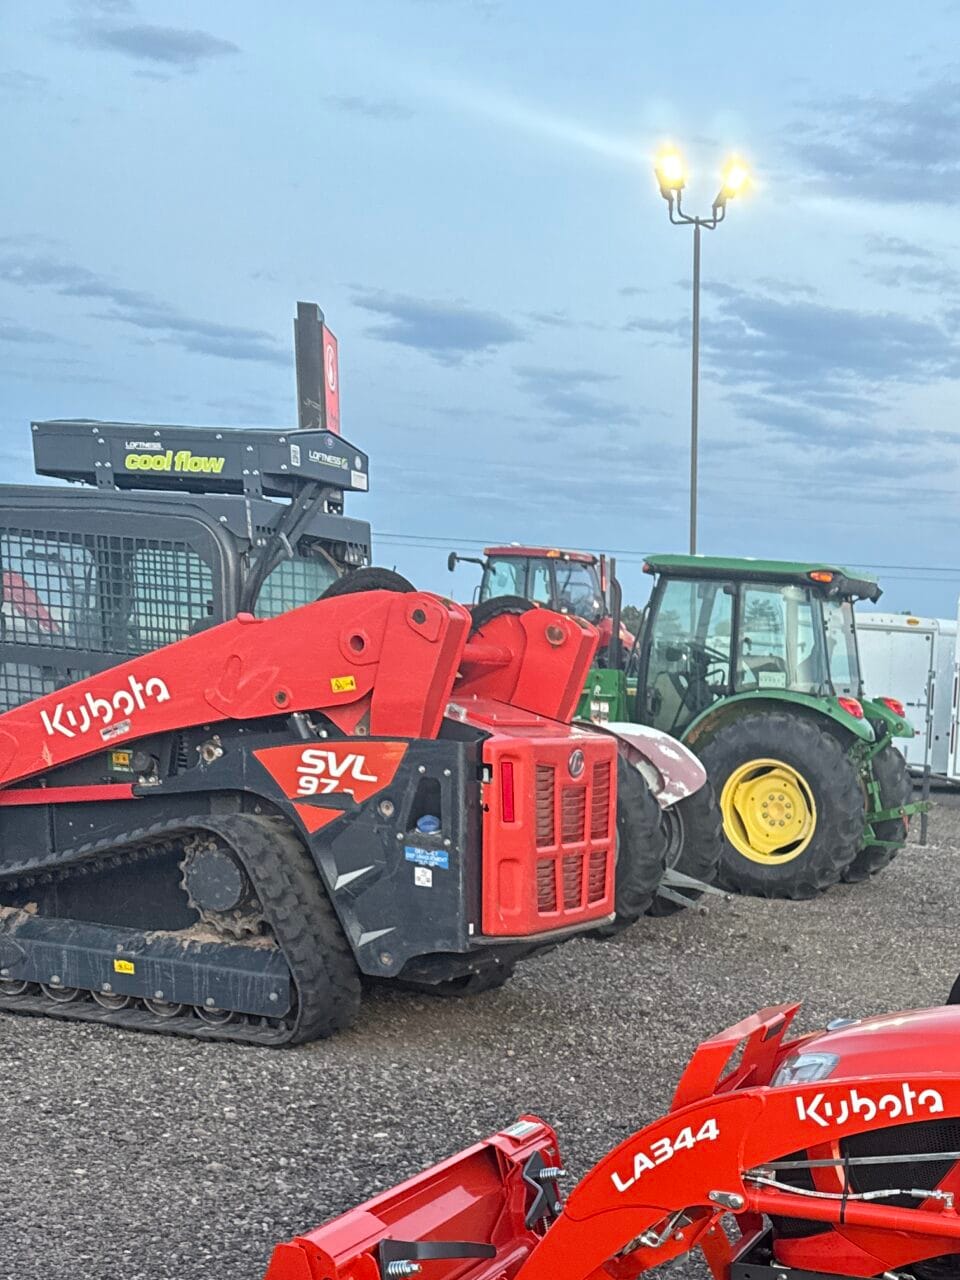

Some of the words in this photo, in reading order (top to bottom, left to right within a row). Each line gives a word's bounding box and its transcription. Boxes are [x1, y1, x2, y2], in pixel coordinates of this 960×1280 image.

[125, 450, 173, 471] cool
[174, 451, 225, 473] flow
[40, 674, 171, 738] Kubota
[296, 749, 378, 782] SVL
[296, 775, 355, 796] 97
[796, 1082, 944, 1127] Kubota
[610, 1118, 720, 1193] LA344
